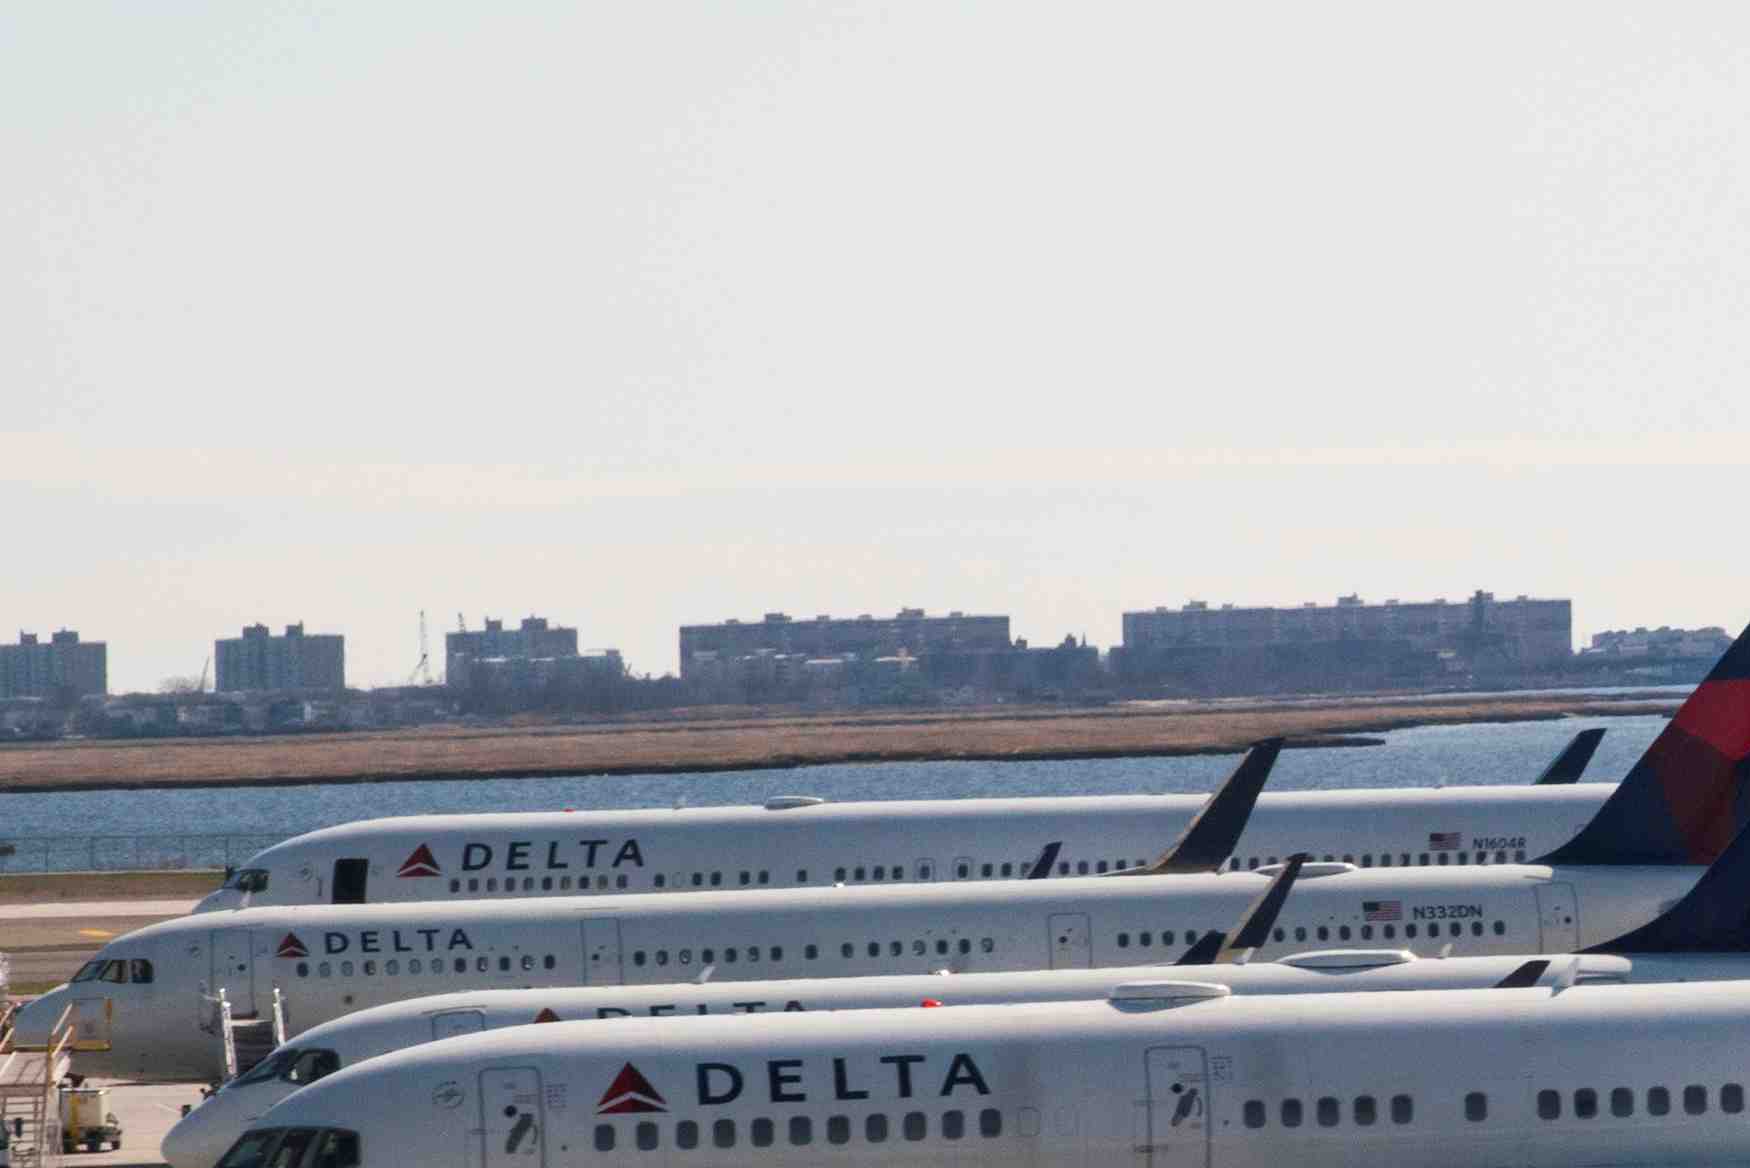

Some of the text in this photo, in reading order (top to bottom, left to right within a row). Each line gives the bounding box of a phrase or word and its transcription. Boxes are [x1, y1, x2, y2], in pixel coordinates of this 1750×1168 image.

[462, 839, 644, 871] DELTA
[1412, 904, 1482, 919] N332DN
[324, 928, 473, 955] DELTA
[696, 1053, 990, 1106] DELTA
